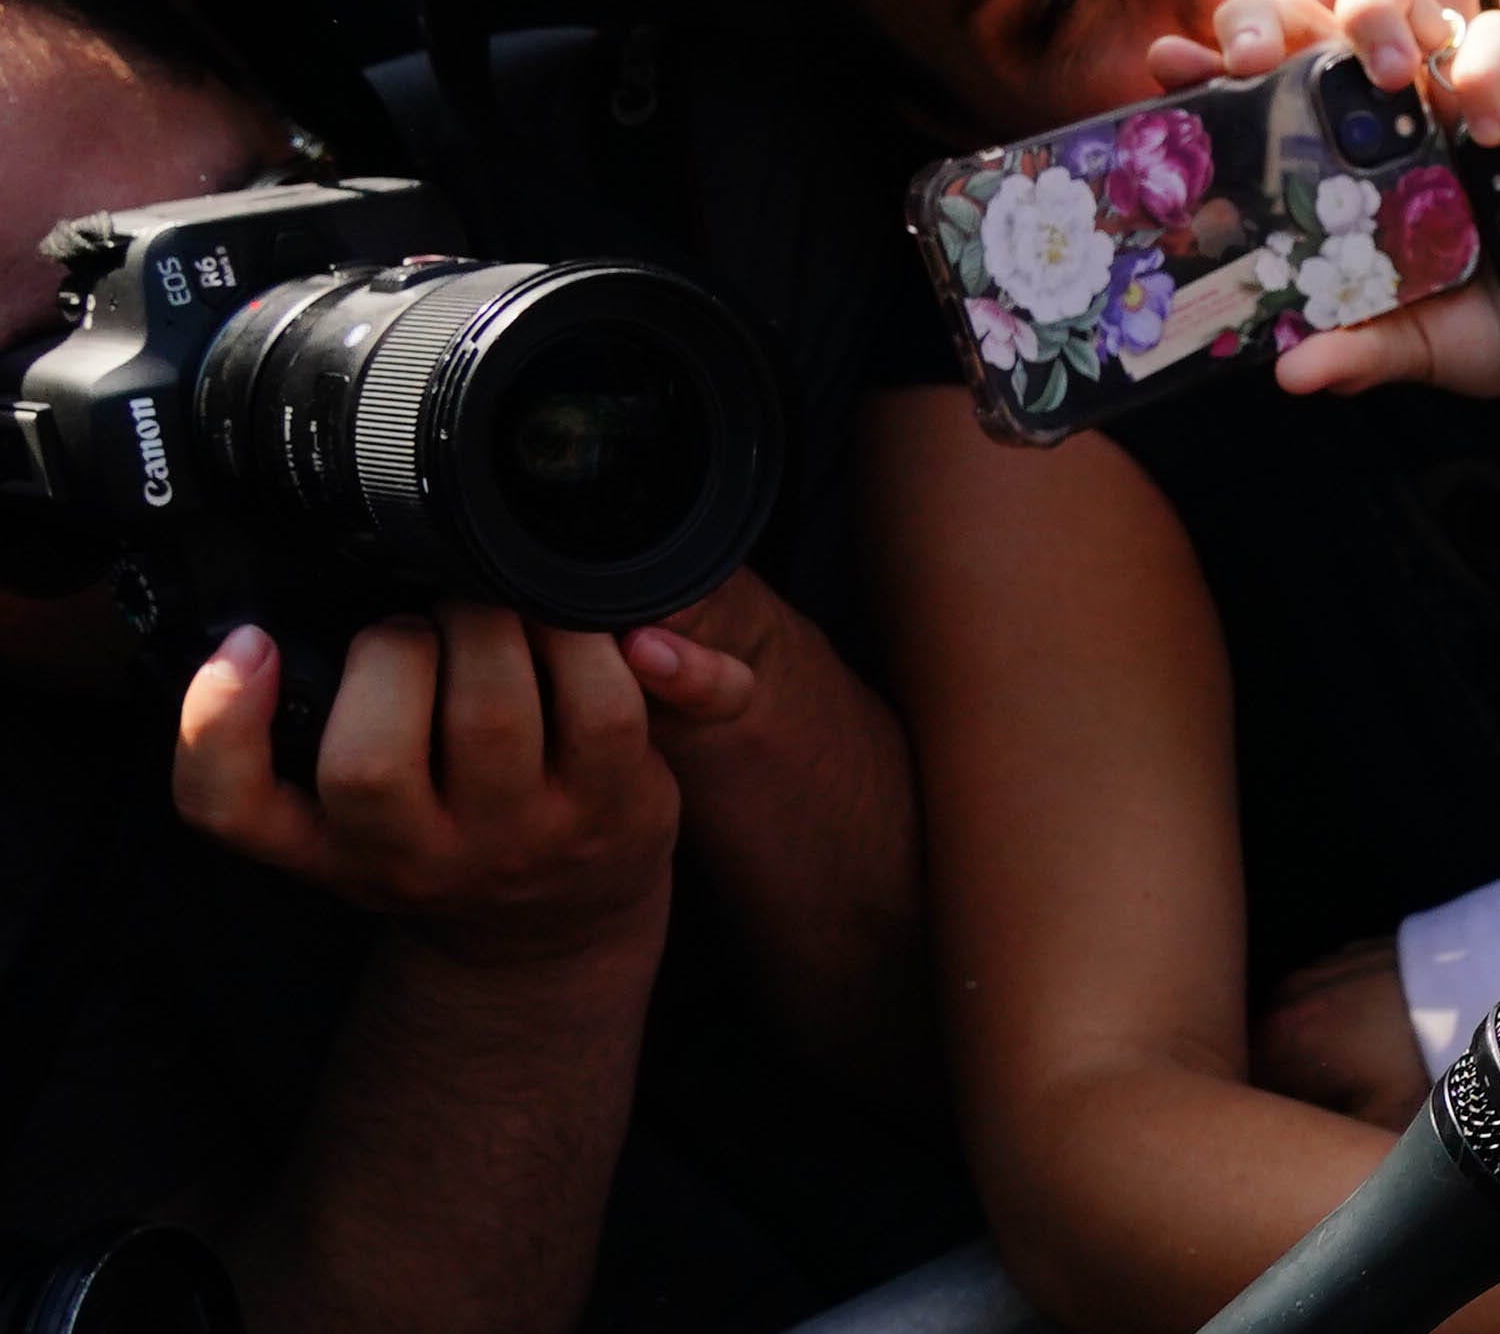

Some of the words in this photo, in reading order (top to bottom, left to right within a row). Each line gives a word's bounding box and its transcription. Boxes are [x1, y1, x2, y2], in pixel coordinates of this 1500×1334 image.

[157, 257, 191, 307] EOS
[194, 255, 223, 288] R6
[129, 398, 172, 507] Canon
